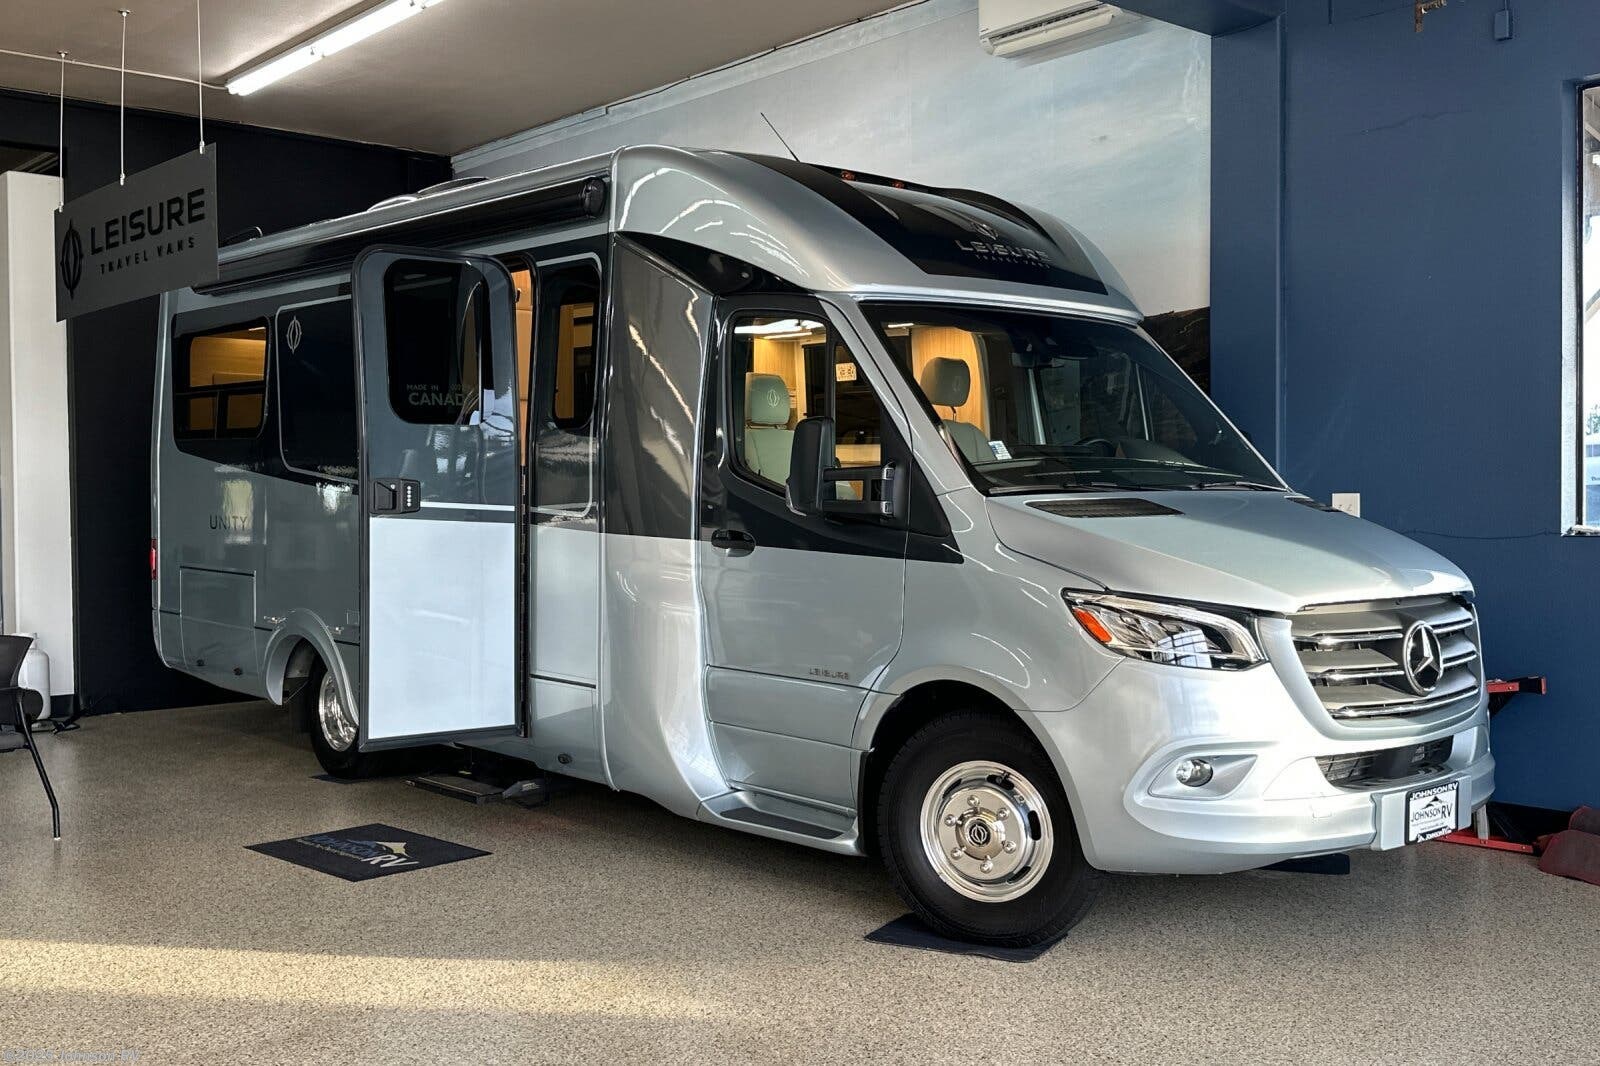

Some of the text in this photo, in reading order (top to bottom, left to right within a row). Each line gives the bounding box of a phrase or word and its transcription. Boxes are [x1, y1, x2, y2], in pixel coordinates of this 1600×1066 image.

[91, 188, 205, 255] LEISURE
[101, 237, 195, 274] TRAVEL VANS
[954, 240, 1051, 262] LEISURE
[408, 392, 465, 406] CANAD
[209, 515, 248, 531] UNITY
[809, 668, 849, 680] LEISURE
[1412, 782, 1459, 799] JOHNSON RV
[1411, 807, 1441, 823] JOHNSON
[1441, 803, 1453, 819] RV
[361, 854, 420, 868] RV
